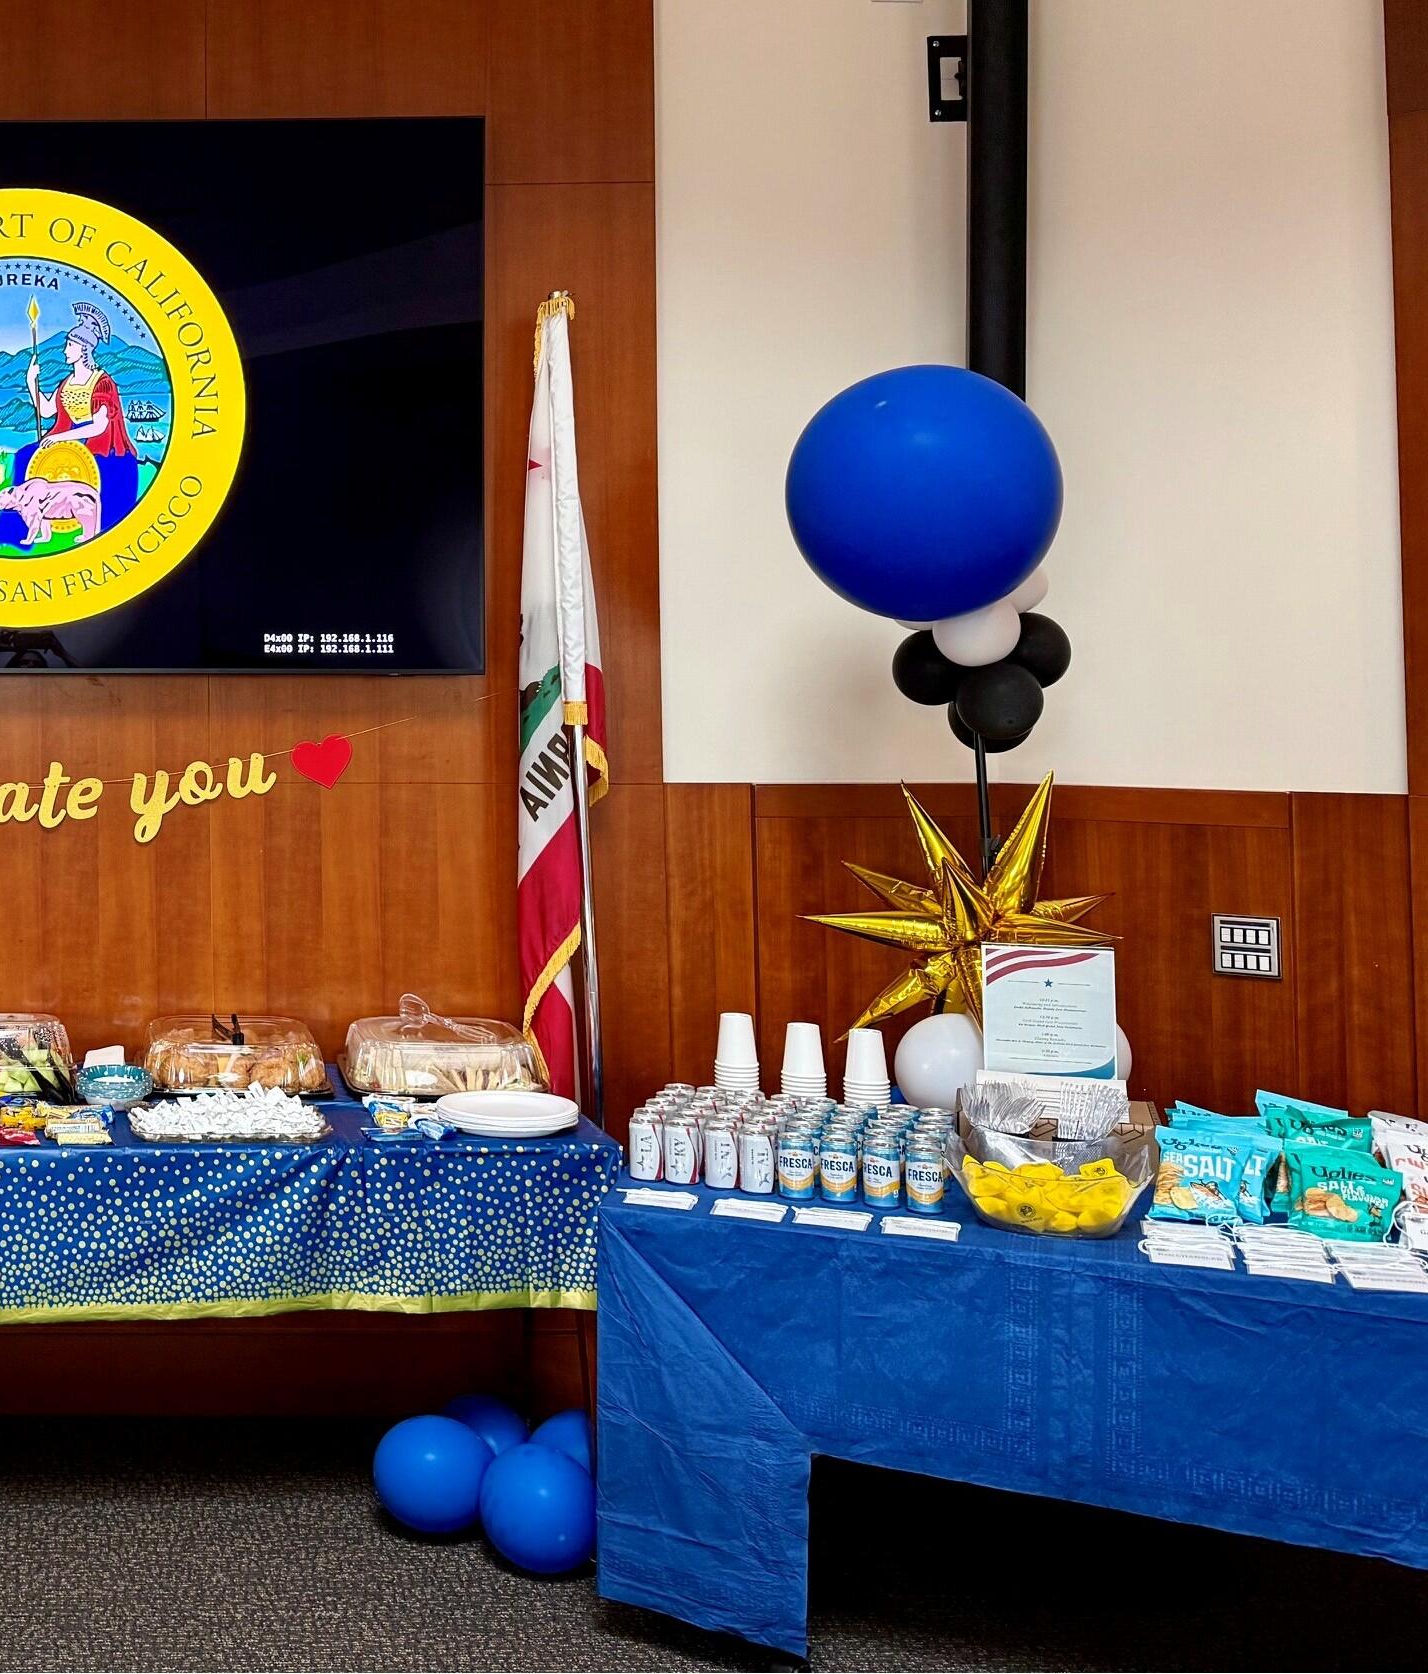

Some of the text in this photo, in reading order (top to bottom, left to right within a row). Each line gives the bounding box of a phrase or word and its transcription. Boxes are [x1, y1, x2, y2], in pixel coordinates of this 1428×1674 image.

[48, 217, 98, 249] OF
[105, 240, 219, 439] CALIFORNIA
[64, 475, 204, 597] FRANCISCO
[298, 633, 314, 643] IP:
[320, 633, 394, 643] 192.168.1.116
[298, 644, 314, 654] IP:
[320, 644, 394, 654] 192.168.1.111
[128, 752, 277, 844] you
[779, 1155, 813, 1170] FRESCA
[820, 1158, 855, 1173] FRESCA
[1163, 1151, 1236, 1182] SEA SALT
[908, 1168, 943, 1183] FRESCA
